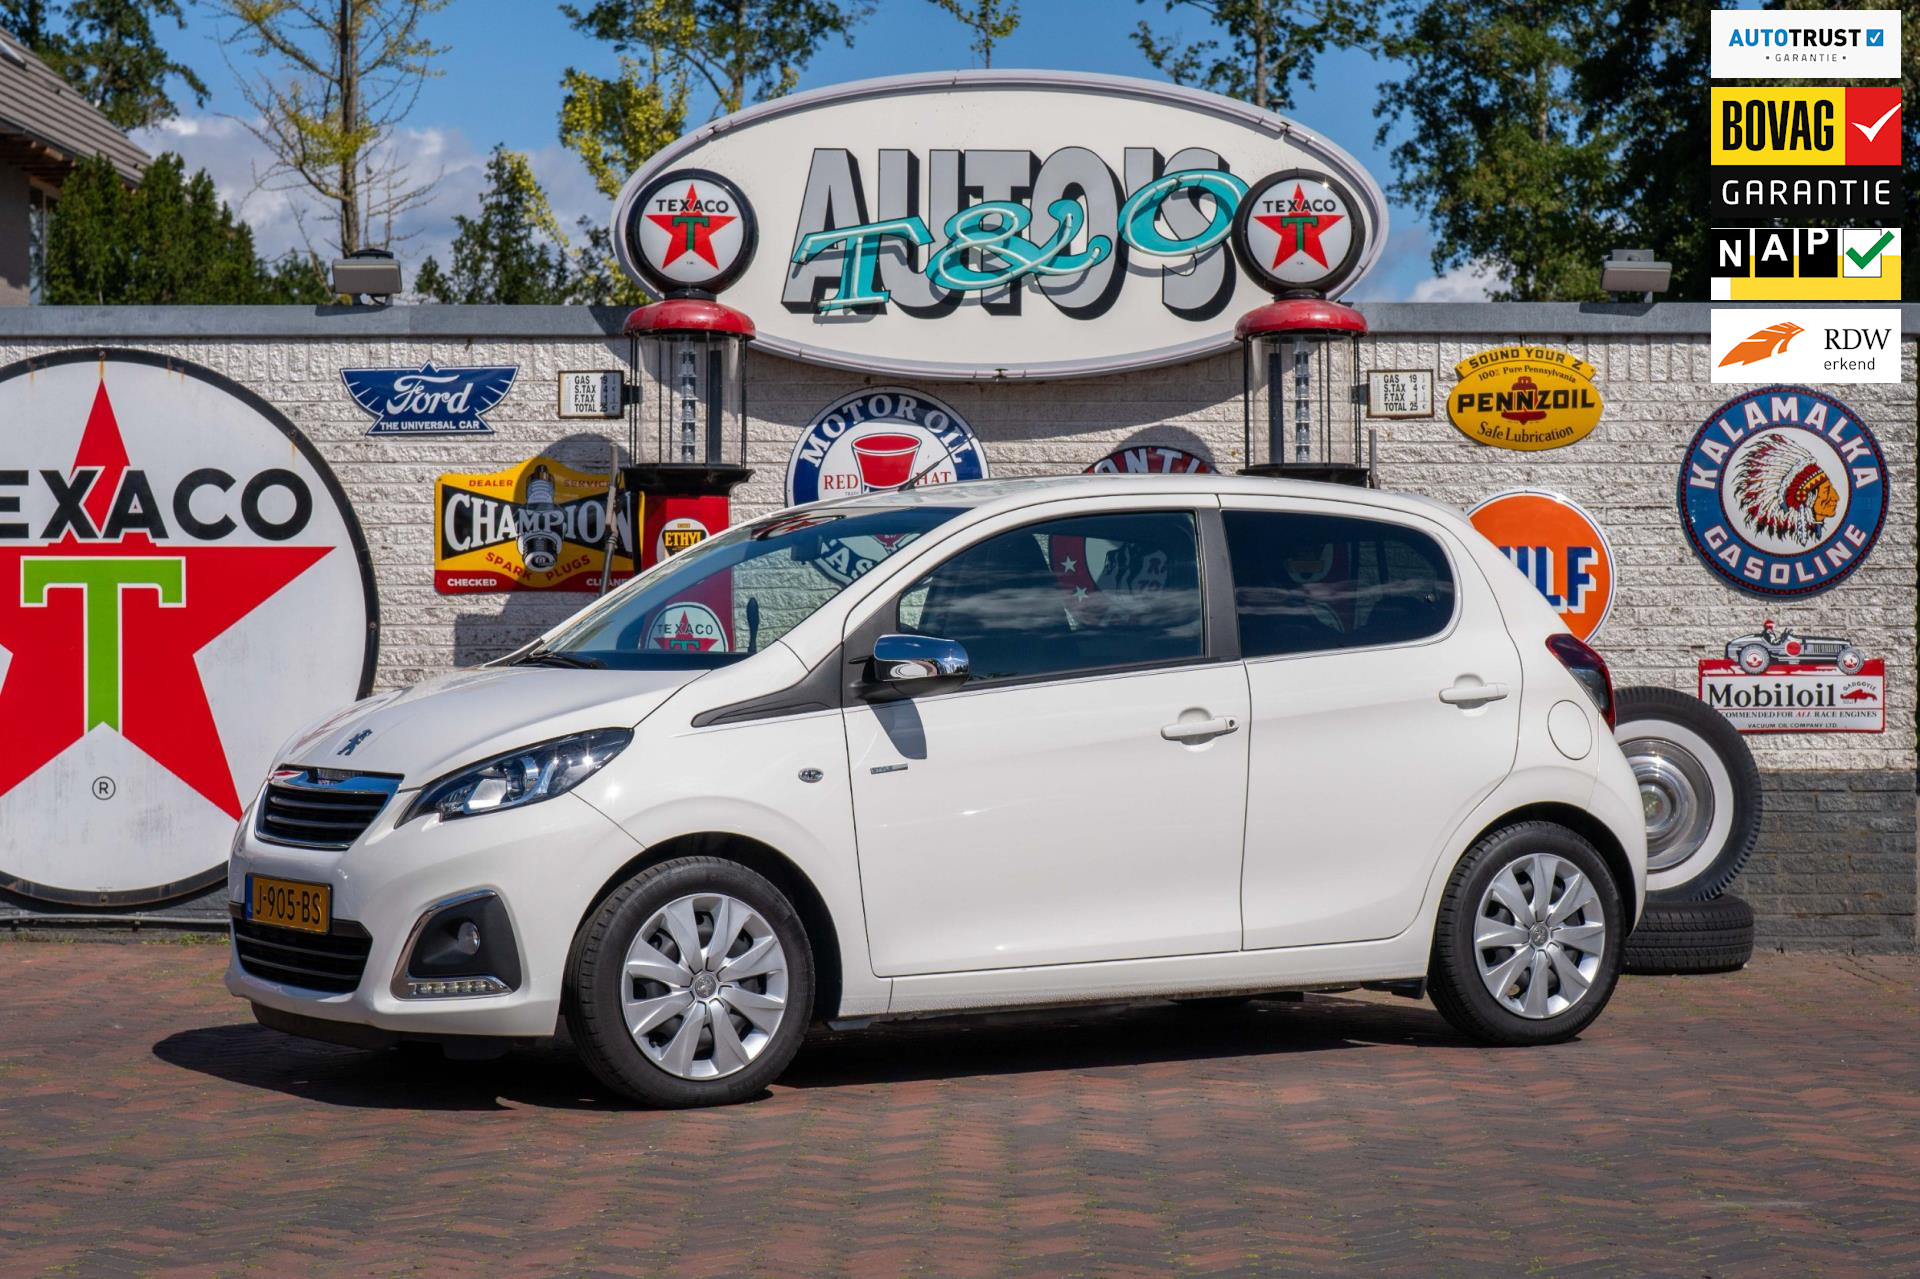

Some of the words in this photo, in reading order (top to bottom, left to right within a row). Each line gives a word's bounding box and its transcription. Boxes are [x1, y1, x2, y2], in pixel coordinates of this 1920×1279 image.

[656, 198, 729, 213] TEXACO
[1263, 198, 1336, 213] TEXACO
[1469, 349, 1519, 369] SOUND
[1525, 349, 1565, 362] YOUR
[1571, 359, 1583, 370] Z
[574, 376, 590, 384] GAS
[1384, 374, 1400, 383] GAS
[1409, 374, 1417, 383] 19
[1503, 366, 1523, 375] Pure
[1524, 366, 1576, 383] Pennsylvania
[386, 374, 473, 415] Ford
[574, 385, 596, 394] S.TAX
[1384, 384, 1405, 392] S.TAX
[1413, 384, 1418, 392] 4
[574, 394, 595, 403] F.TAX
[1384, 393, 1405, 402] F.TAX
[1458, 389, 1595, 413] PENNZOIL
[574, 404, 597, 412] TOTAL
[1384, 403, 1407, 411] TOTAL
[1409, 402, 1418, 411] 25
[380, 422, 399, 430] THE
[401, 421, 456, 430] UNIVERSAL
[458, 421, 480, 429] CAR
[800, 394, 918, 468] MOTOR
[924, 409, 973, 463] OIL
[1477, 421, 1503, 439] Safe
[1505, 426, 1574, 442] Lubrication
[1690, 396, 1878, 489] KALAMALKA
[469, 479, 513, 487] DEALER
[824, 474, 858, 489] RED
[915, 471, 951, 487] HAT
[0, 467, 313, 540] EXACO
[444, 490, 633, 553] CHAMPION
[1704, 524, 1866, 584] GASOLINE
[485, 552, 533, 580] SPARK
[546, 555, 591, 580] PLUGS
[447, 578, 497, 587] CHECKED
[656, 624, 713, 635] TEXACO
[1707, 683, 1836, 707] Mobiloil
[256, 884, 321, 925] J-905-BS
